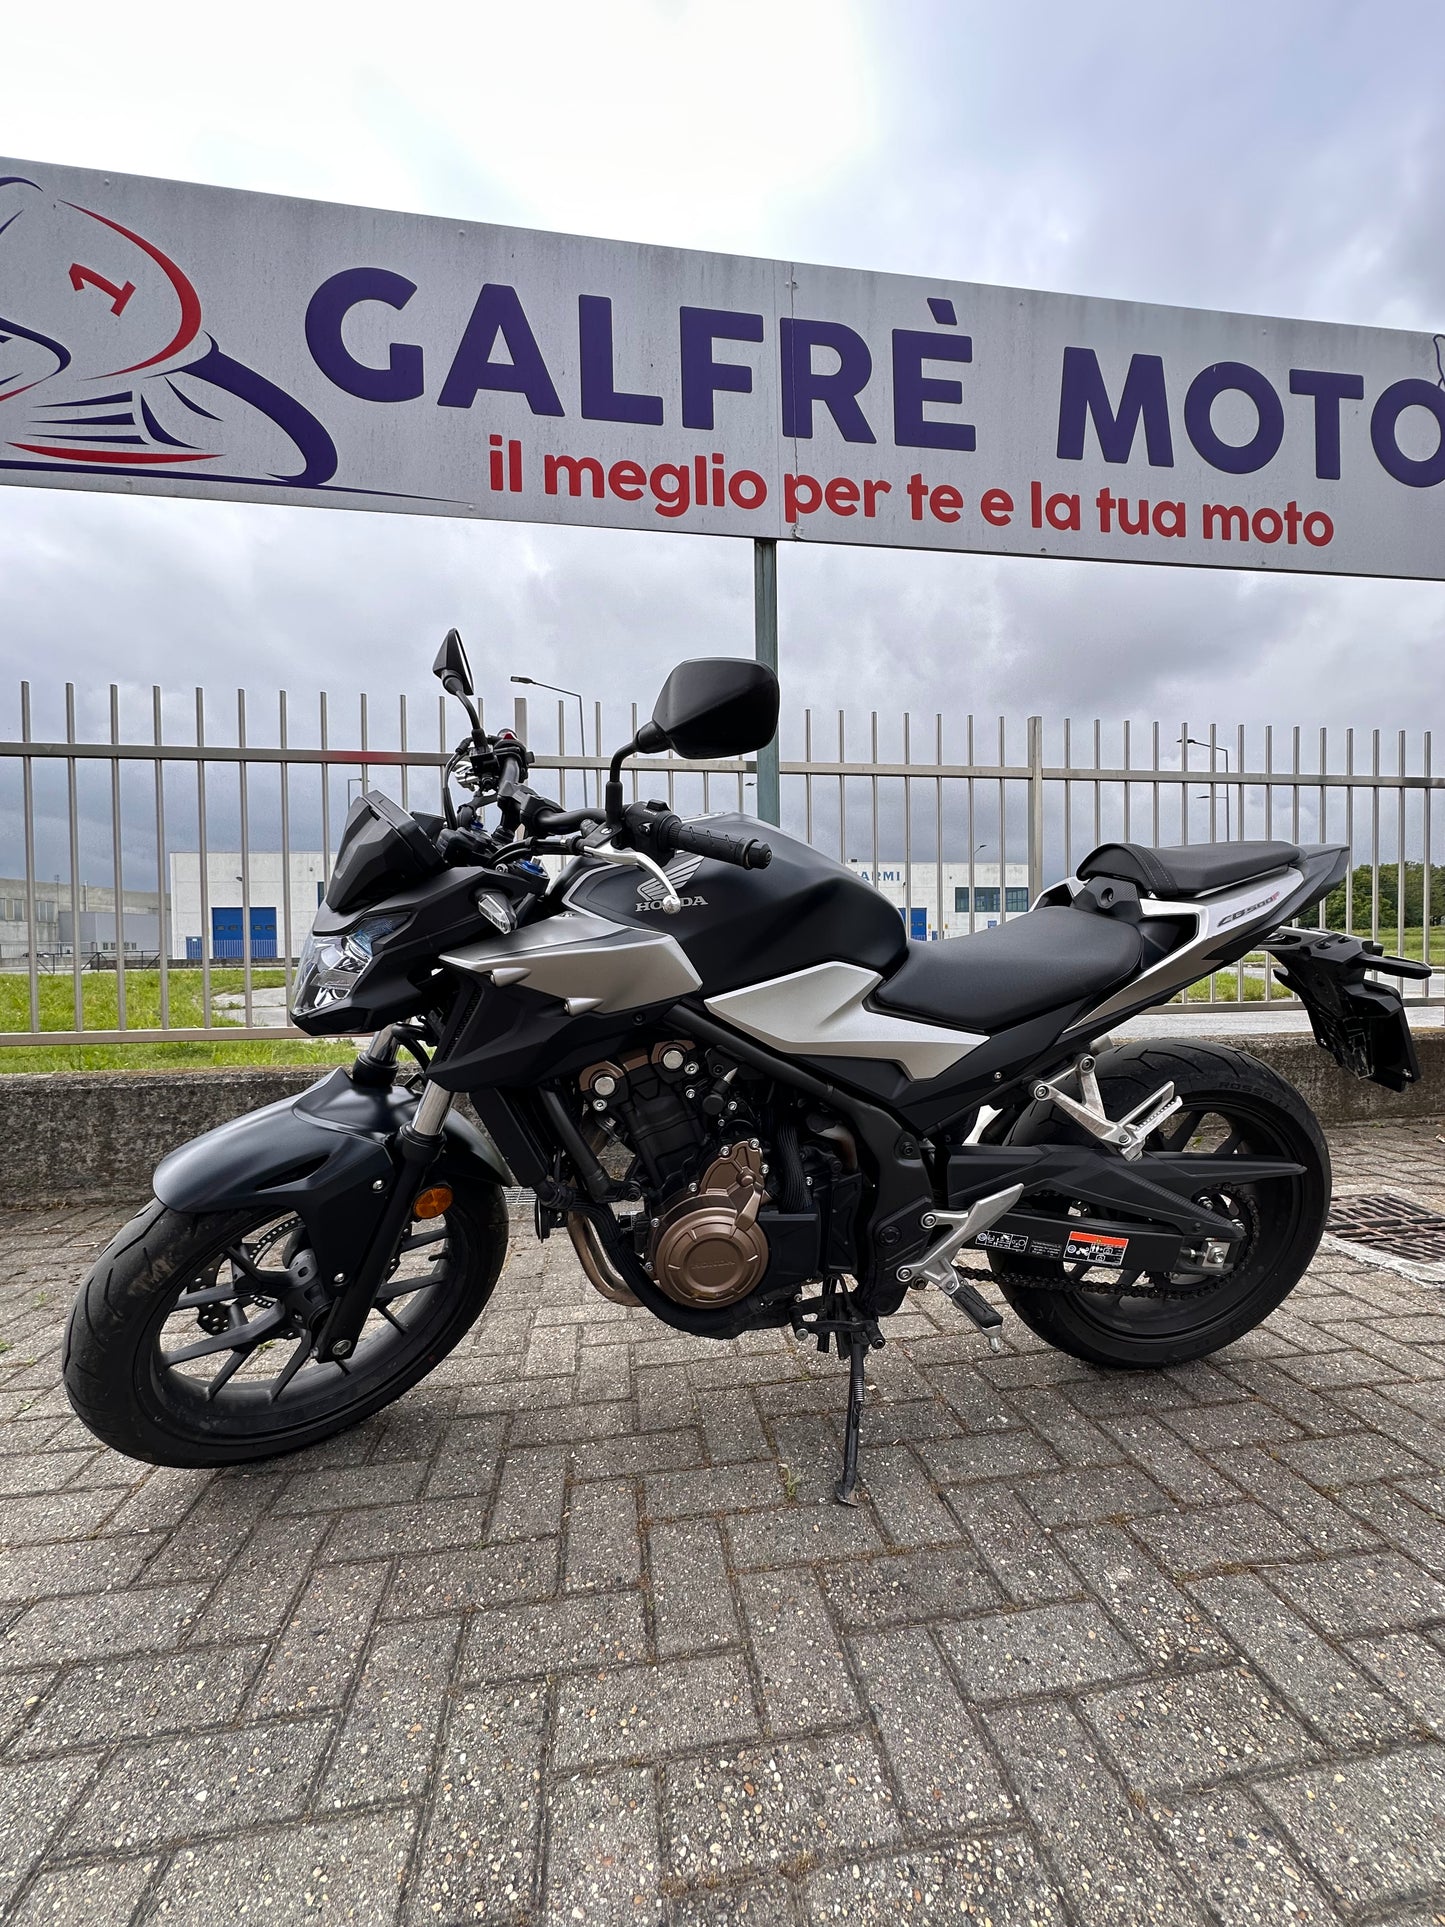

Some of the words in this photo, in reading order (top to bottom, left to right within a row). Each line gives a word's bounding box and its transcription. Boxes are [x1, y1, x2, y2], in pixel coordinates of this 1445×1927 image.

[304, 267, 976, 452] GALFRÈ
[1056, 346, 1445, 488] MOTO
[489, 434, 523, 493] il
[544, 453, 768, 518] meglio
[783, 473, 892, 524] per
[906, 473, 964, 523] te
[980, 488, 1014, 527] e
[1031, 481, 1081, 531] la
[1096, 487, 1186, 538] tua
[1202, 501, 1334, 547] moto
[635, 895, 709, 912] HODA
